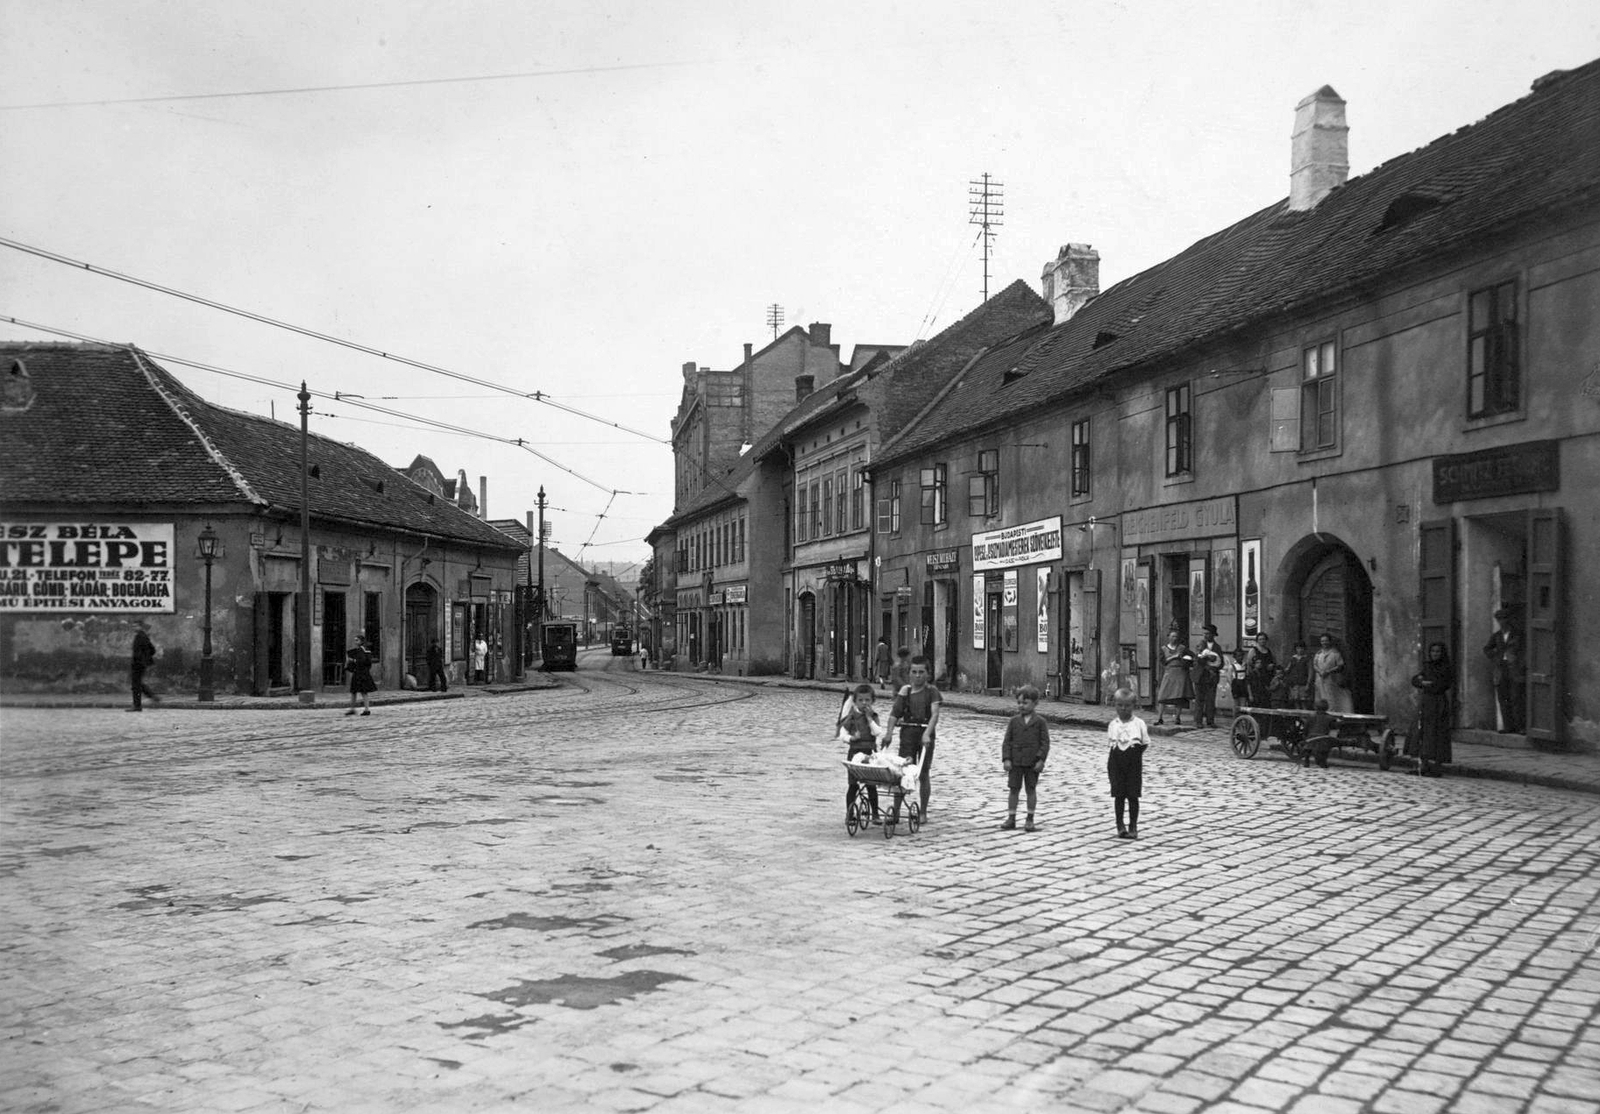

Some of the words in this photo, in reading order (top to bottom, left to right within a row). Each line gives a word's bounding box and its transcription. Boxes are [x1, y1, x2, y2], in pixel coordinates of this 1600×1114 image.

[1196, 500, 1235, 527] GYULA
[0, 525, 47, 539] SZ
[57, 524, 138, 539] BÉLA
[36, 570, 96, 581] TELEFON
[88, 598, 166, 608] ANYAGOK.
